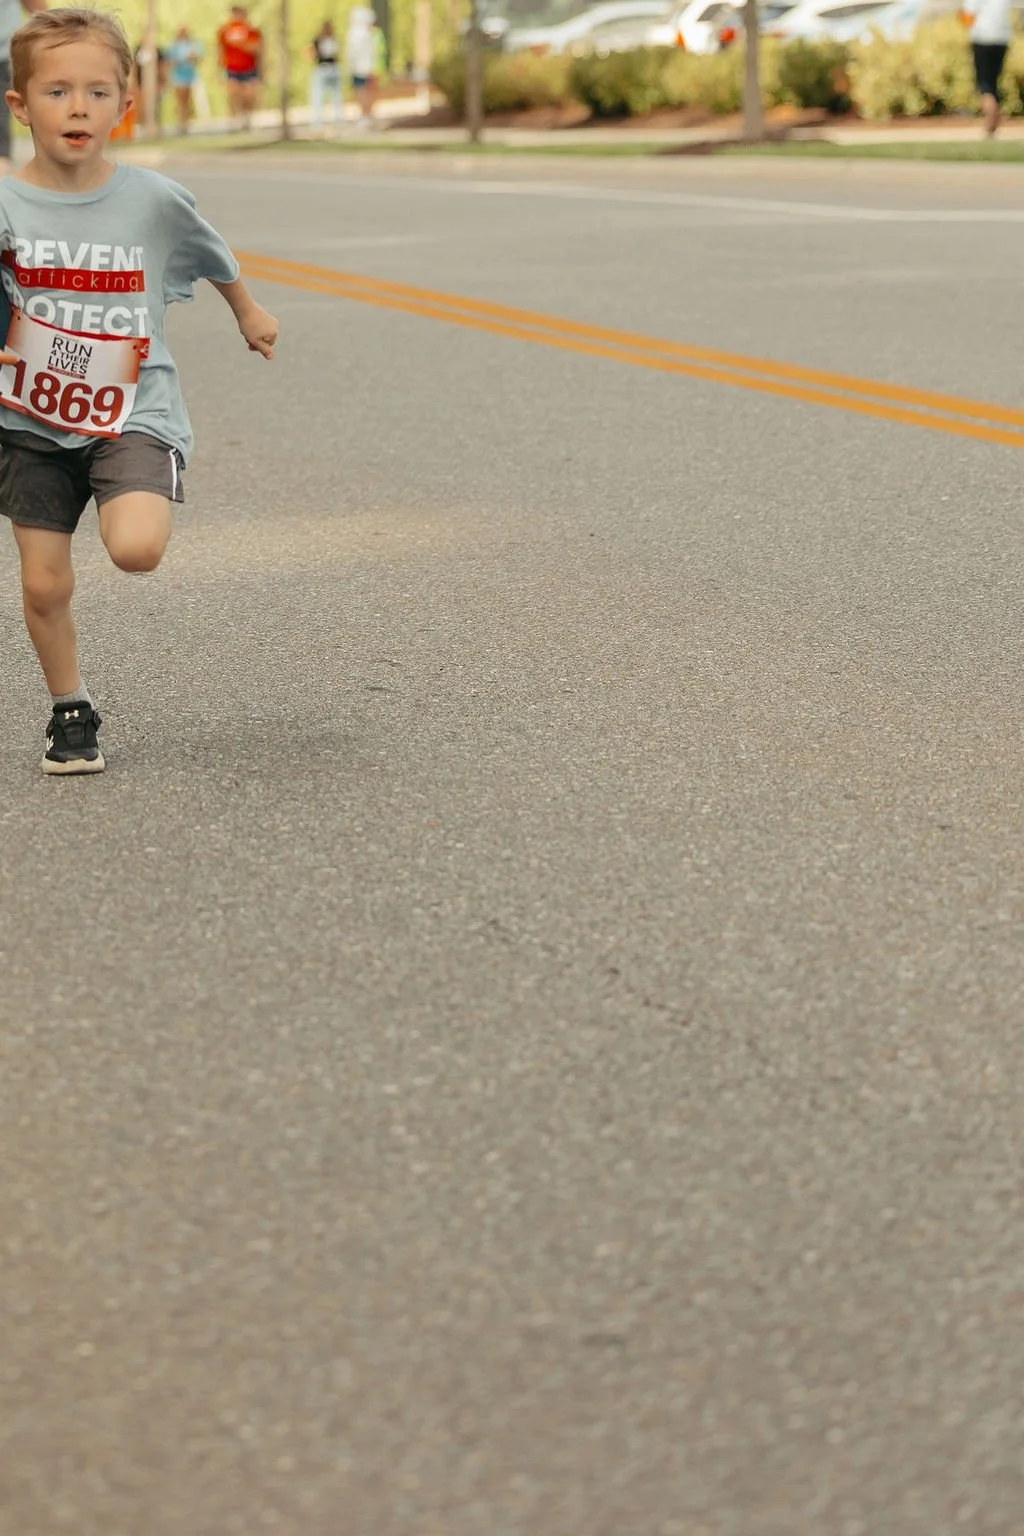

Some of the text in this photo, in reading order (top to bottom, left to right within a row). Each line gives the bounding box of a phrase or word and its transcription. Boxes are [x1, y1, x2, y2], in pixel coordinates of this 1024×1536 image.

[18, 268, 140, 293] afficking
[52, 336, 93, 358] RUN
[60, 351, 90, 365] THEIR
[48, 355, 88, 375] LIVES
[12, 359, 125, 428] 1869
